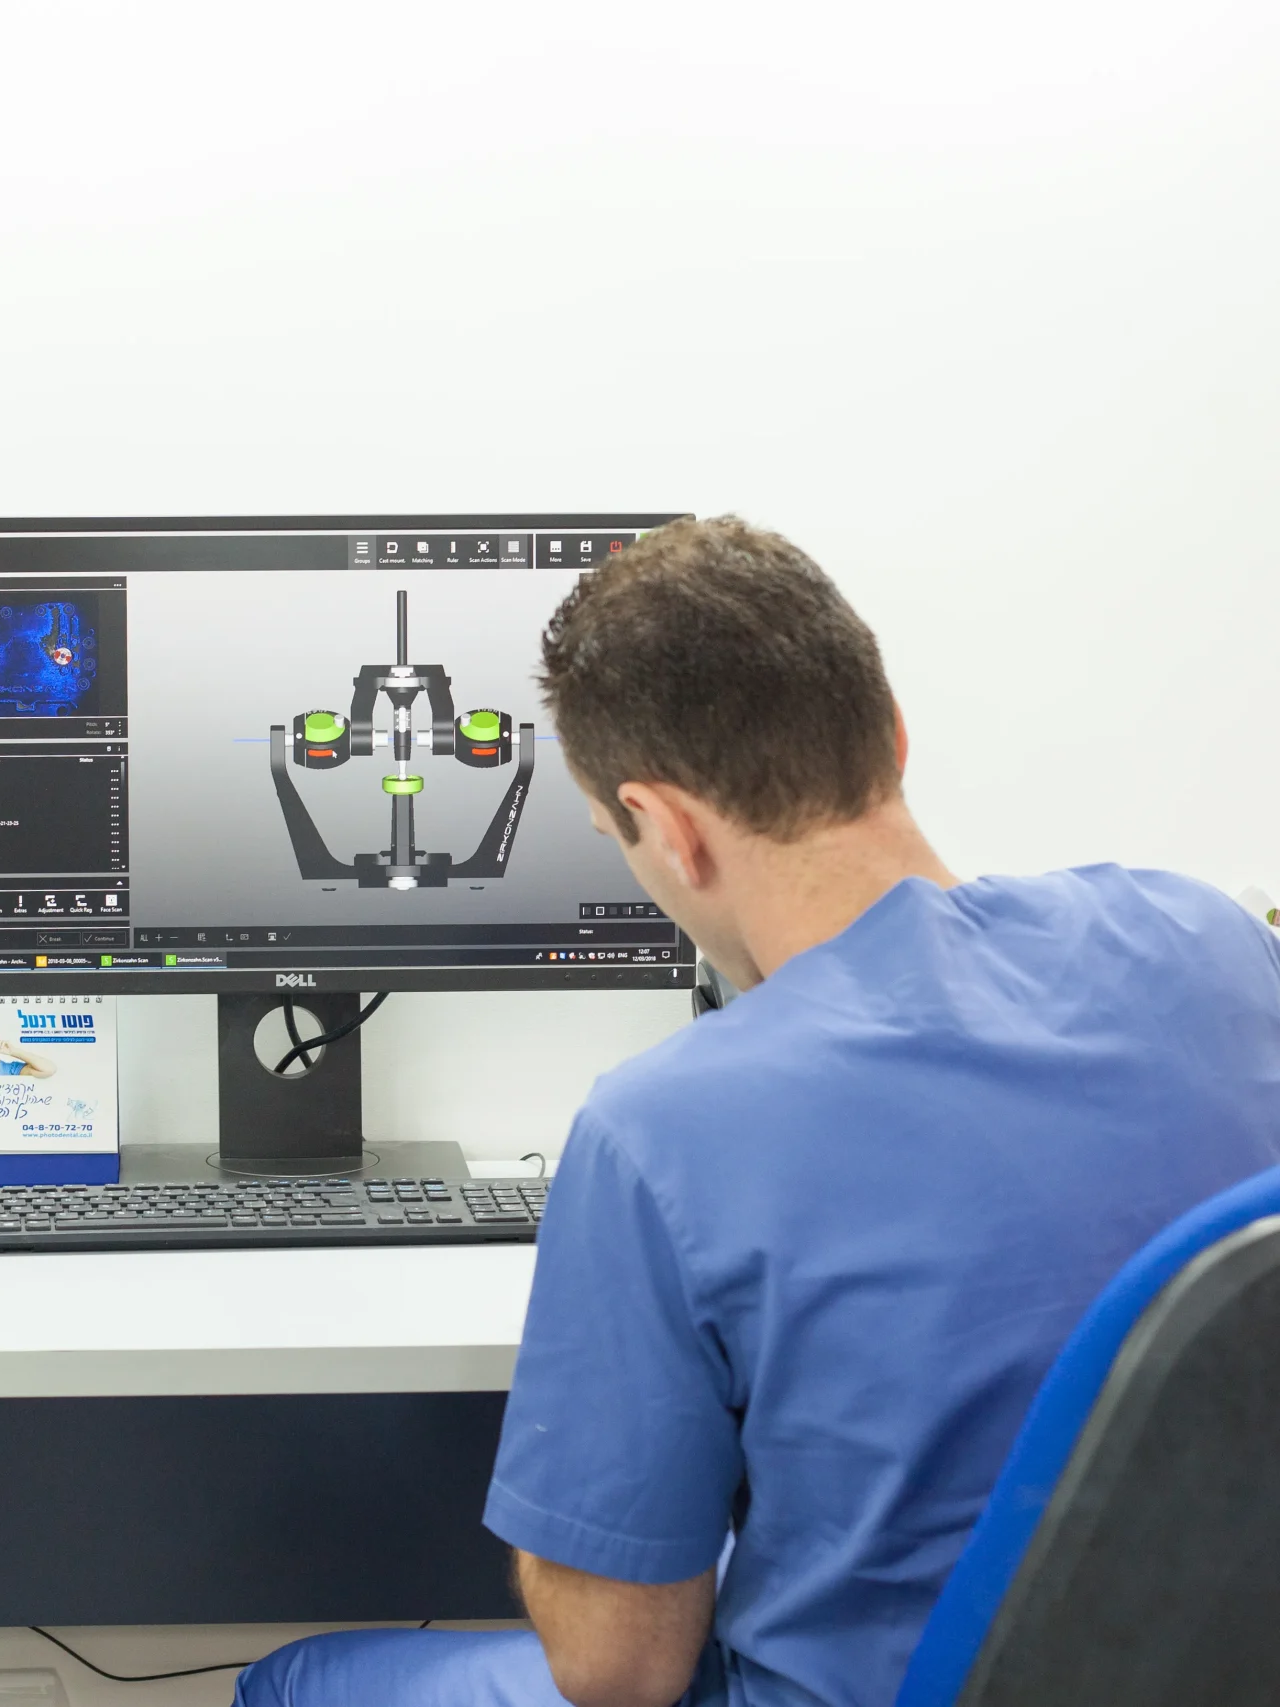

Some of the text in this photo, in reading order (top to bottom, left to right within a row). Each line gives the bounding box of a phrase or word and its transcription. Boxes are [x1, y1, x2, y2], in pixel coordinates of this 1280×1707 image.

[497, 785, 523, 862] ZIRKONZAHN
[276, 973, 316, 988] DELL
[17, 1009, 94, 1028] פוטו דנטל
[14, 1102, 28, 1120] כל
